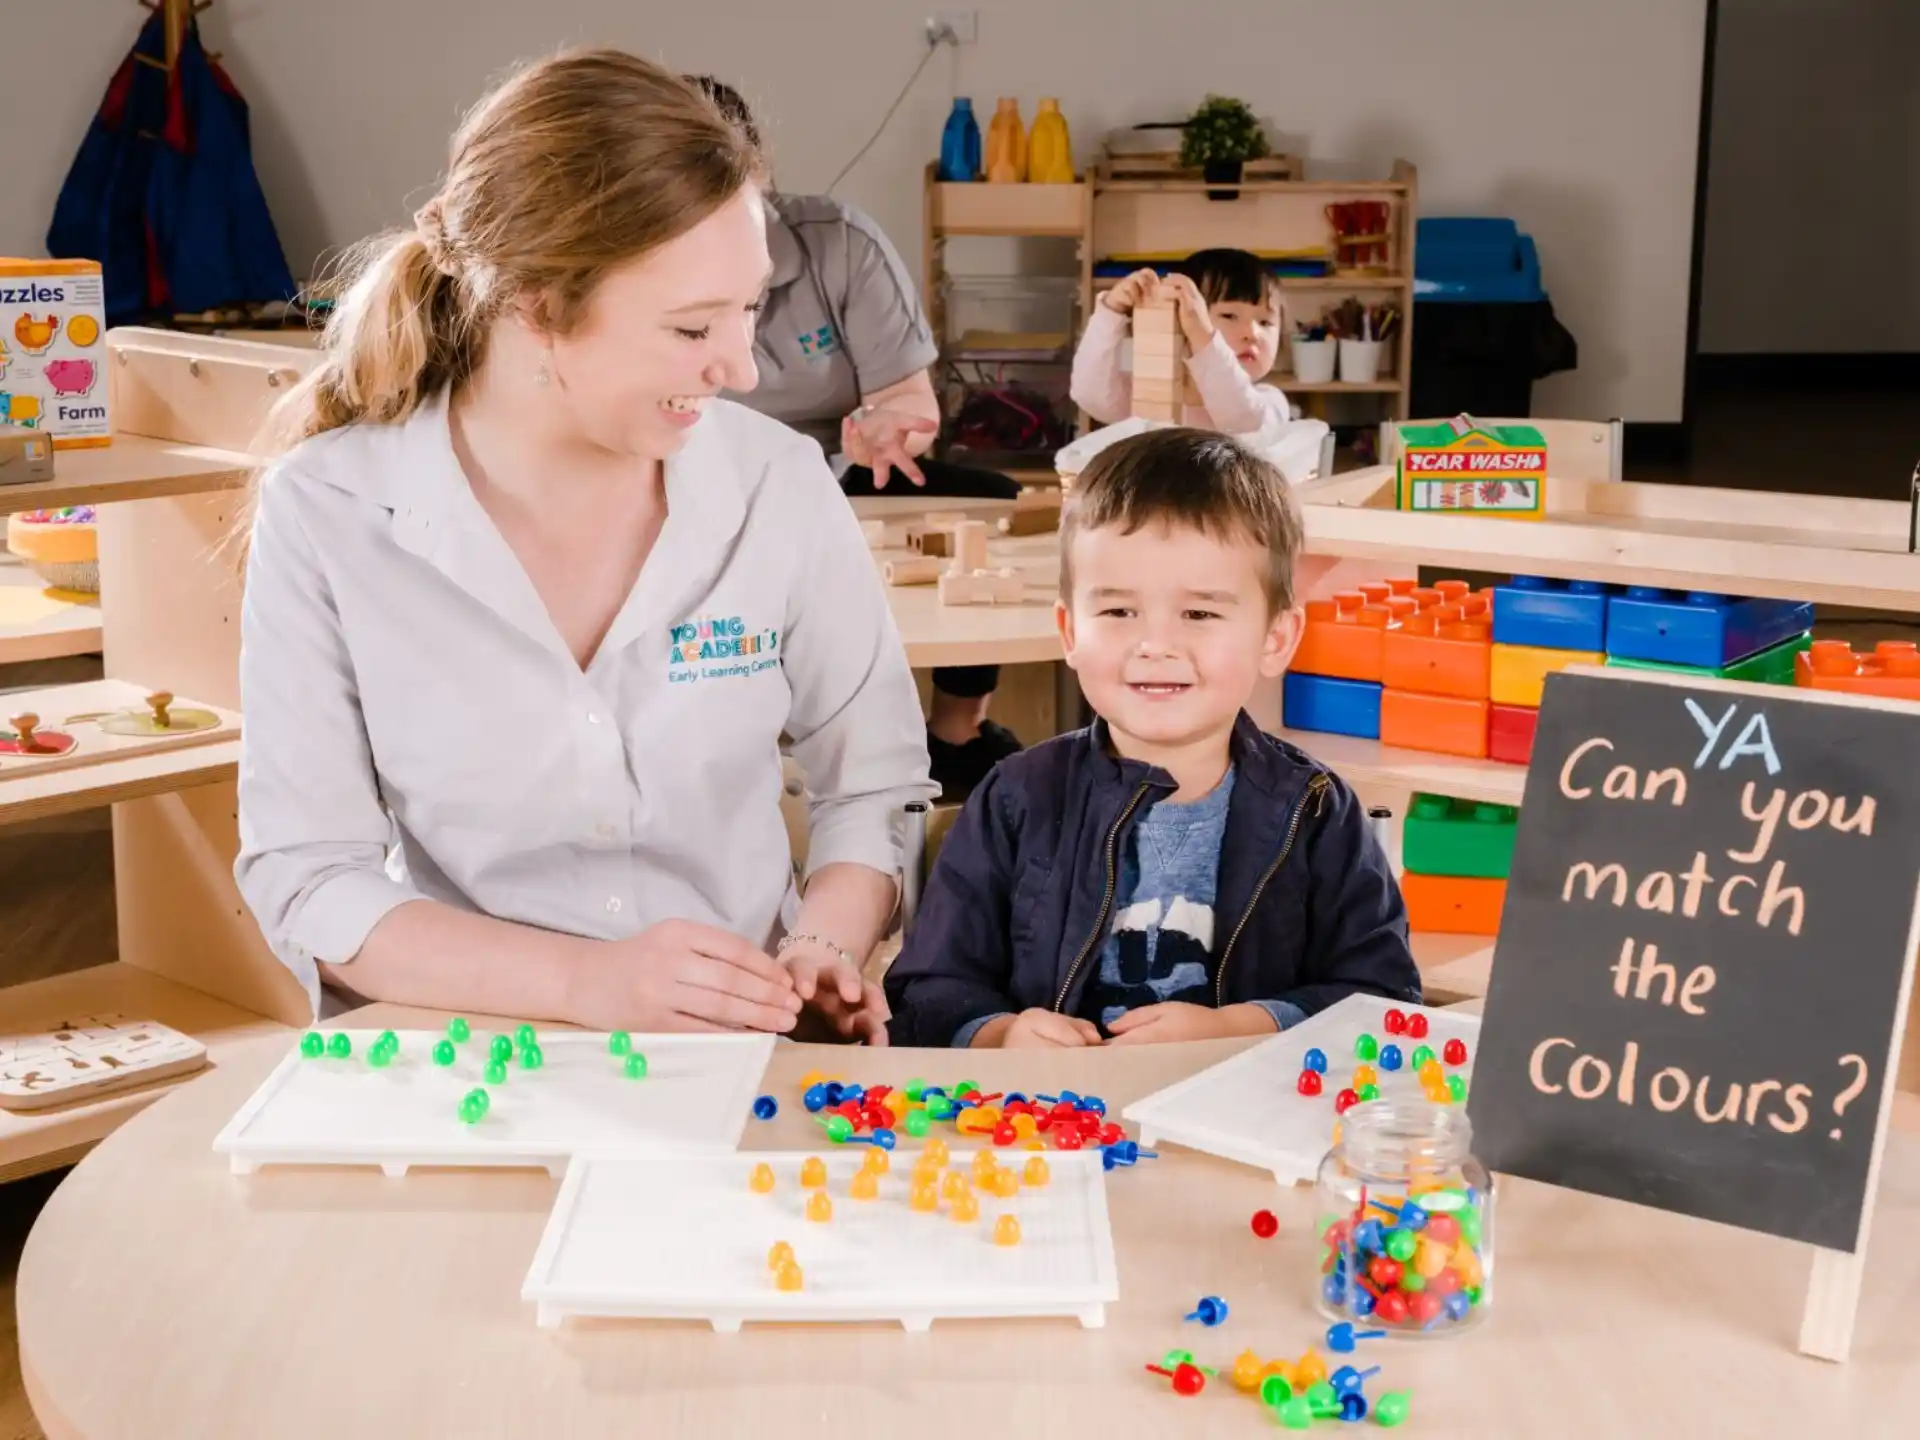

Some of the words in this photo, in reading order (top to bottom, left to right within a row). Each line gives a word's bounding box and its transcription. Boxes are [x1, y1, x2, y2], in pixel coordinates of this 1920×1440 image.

[0, 282, 64, 303] zzles
[59, 406, 105, 421] Farm
[1421, 453, 1464, 470] CAR
[1470, 453, 1529, 469] WASH
[670, 616, 745, 645] YOUNG
[668, 669, 699, 682] Early
[702, 664, 750, 678] Learning
[1684, 698, 1782, 775] YA
[1559, 738, 1687, 806] Can
[1727, 781, 1877, 863] you
[1562, 851, 1806, 936] match
[1610, 937, 1717, 1015] the
